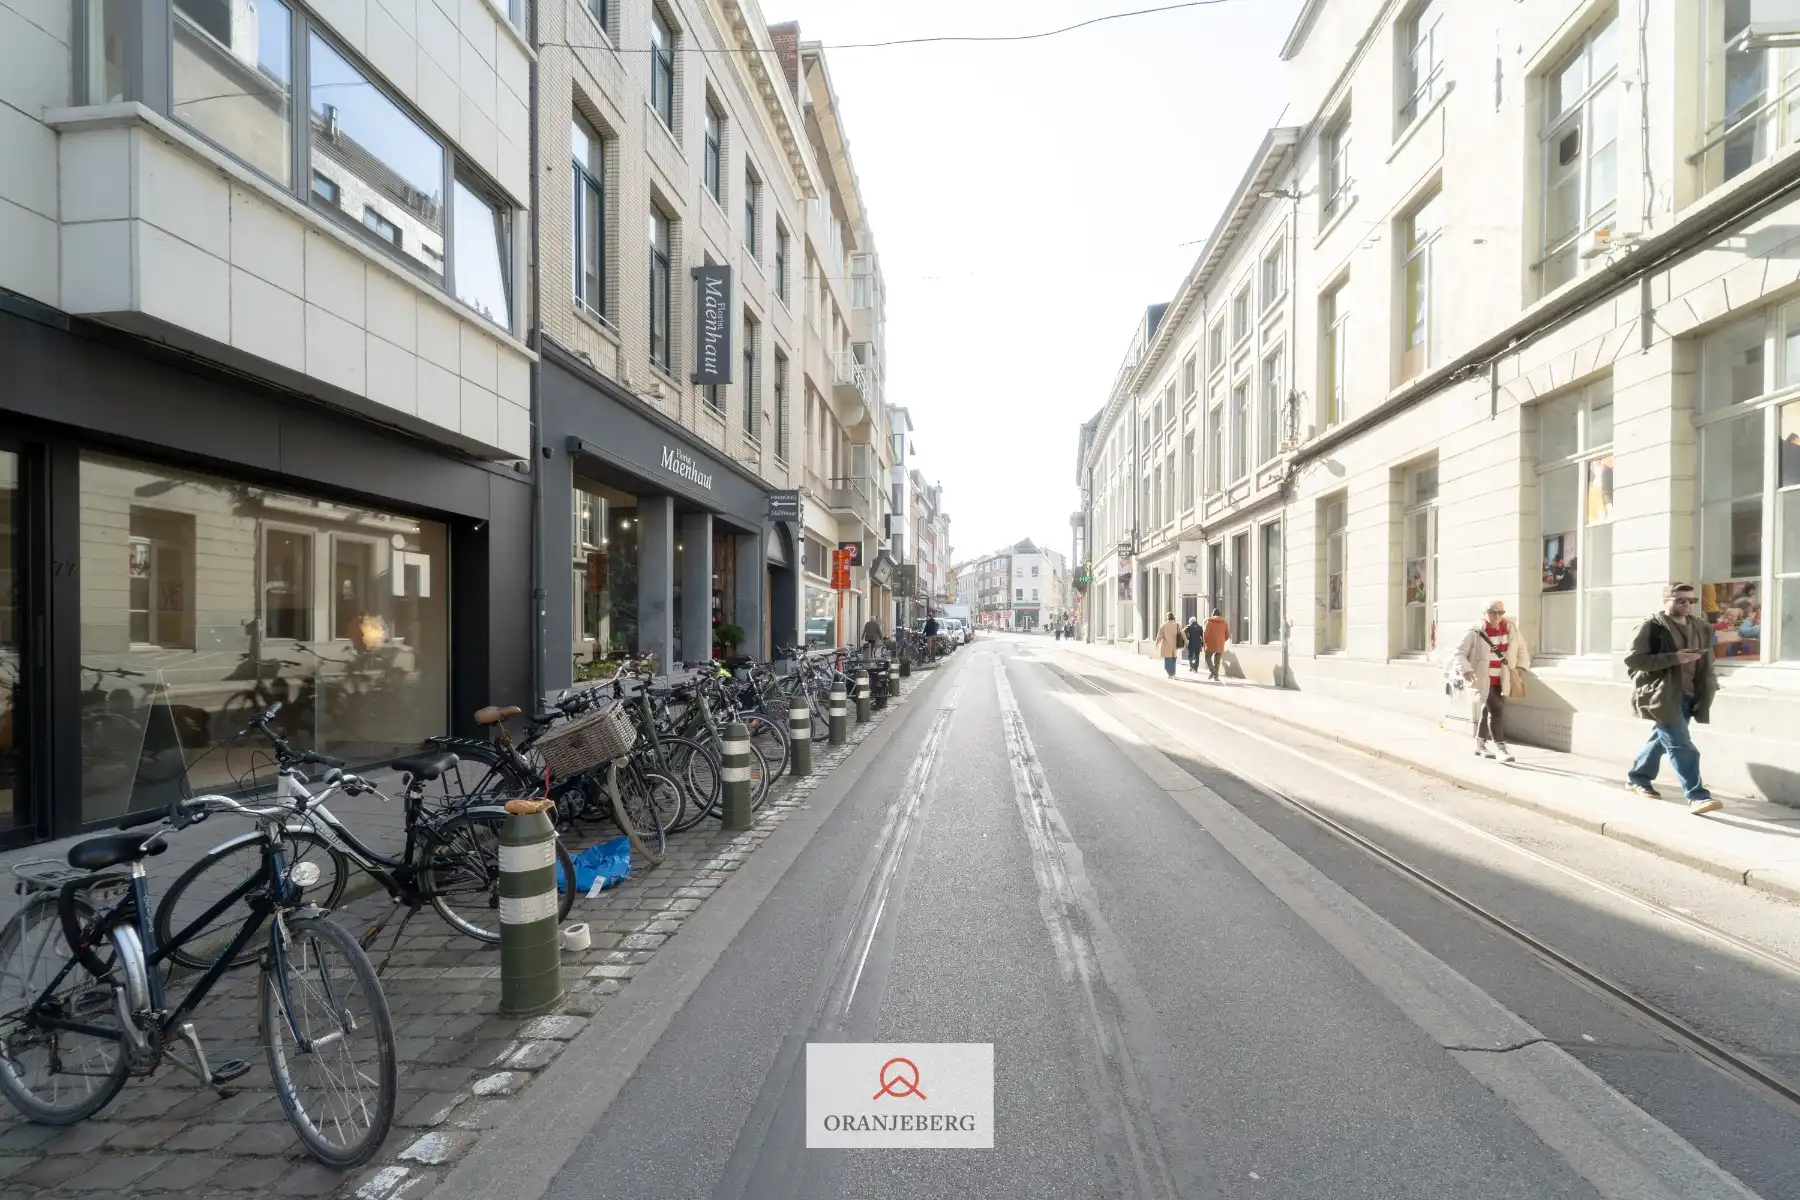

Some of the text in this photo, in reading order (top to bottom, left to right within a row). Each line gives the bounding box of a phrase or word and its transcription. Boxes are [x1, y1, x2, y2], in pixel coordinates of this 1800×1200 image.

[705, 275, 722, 375] Maenhaut
[717, 302, 726, 330] Florist
[660, 445, 712, 490] Maenhaut
[53, 560, 76, 577] 77
